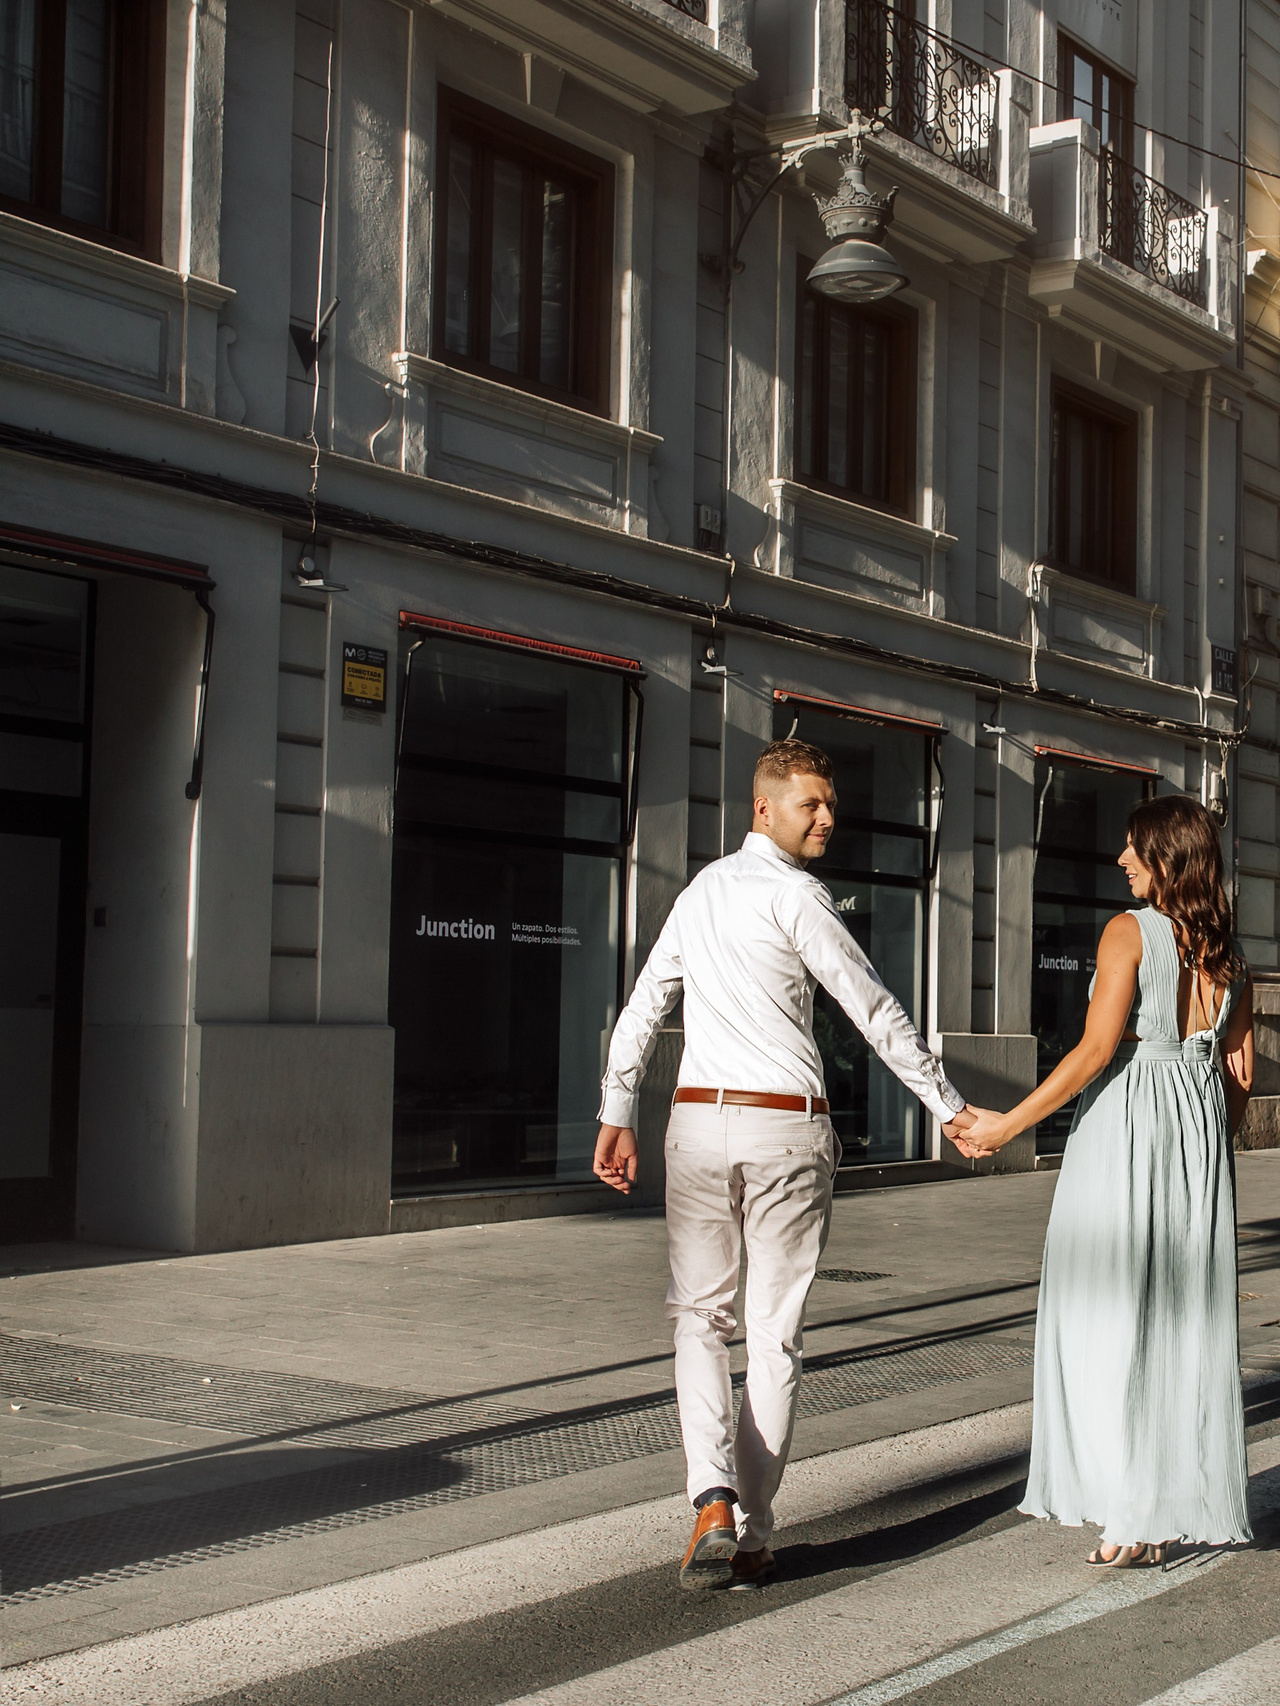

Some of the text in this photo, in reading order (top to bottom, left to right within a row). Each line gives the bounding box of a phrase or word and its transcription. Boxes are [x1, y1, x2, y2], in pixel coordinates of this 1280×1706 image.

[1215, 648, 1234, 664] CALLE
[415, 915, 579, 940] Junction Un zapato. Dos estilos.
[512, 933, 582, 946] Múltiples posibilidades.
[1039, 954, 1078, 970] Junction
